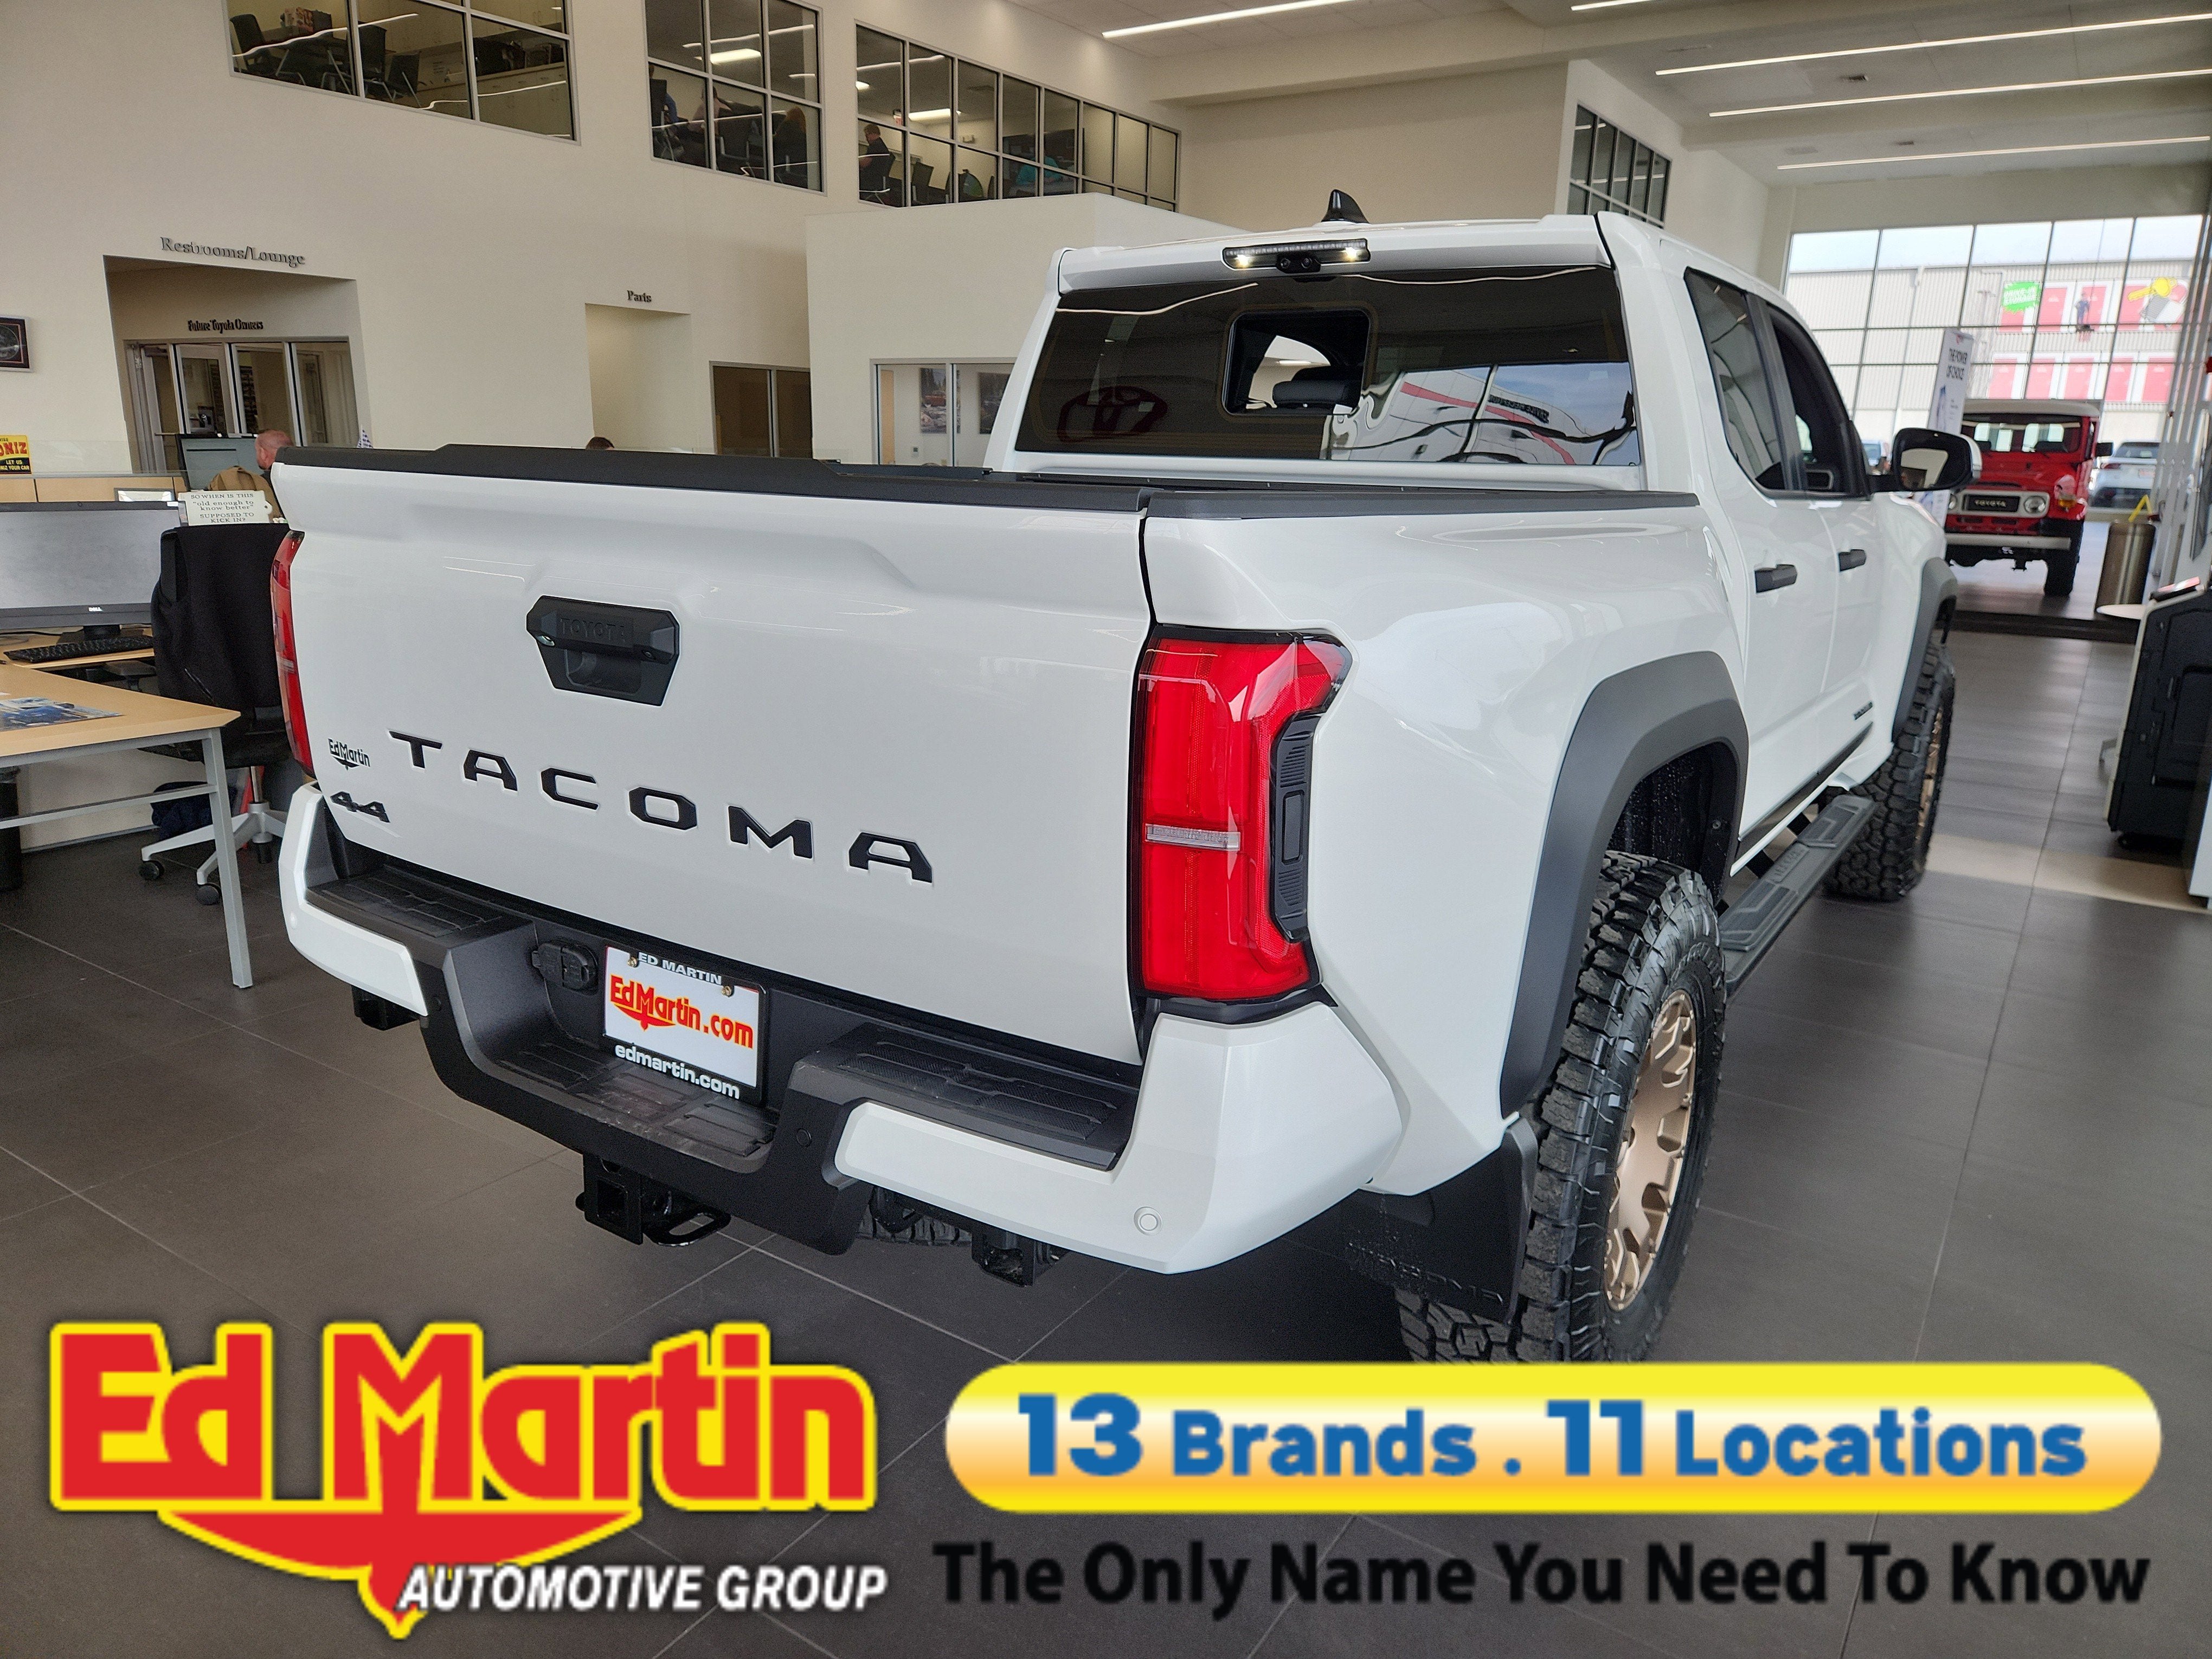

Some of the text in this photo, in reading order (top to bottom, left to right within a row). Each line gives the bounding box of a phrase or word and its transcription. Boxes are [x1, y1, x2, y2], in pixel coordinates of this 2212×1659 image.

[627, 290, 652, 303] Parts
[188, 318, 263, 333] Future Toyota Owners
[560, 618, 627, 644] TOYOTA
[388, 730, 933, 884] TACOMA
[638, 951, 722, 985] ED MARTIN
[615, 1044, 740, 1100] edmartin.com
